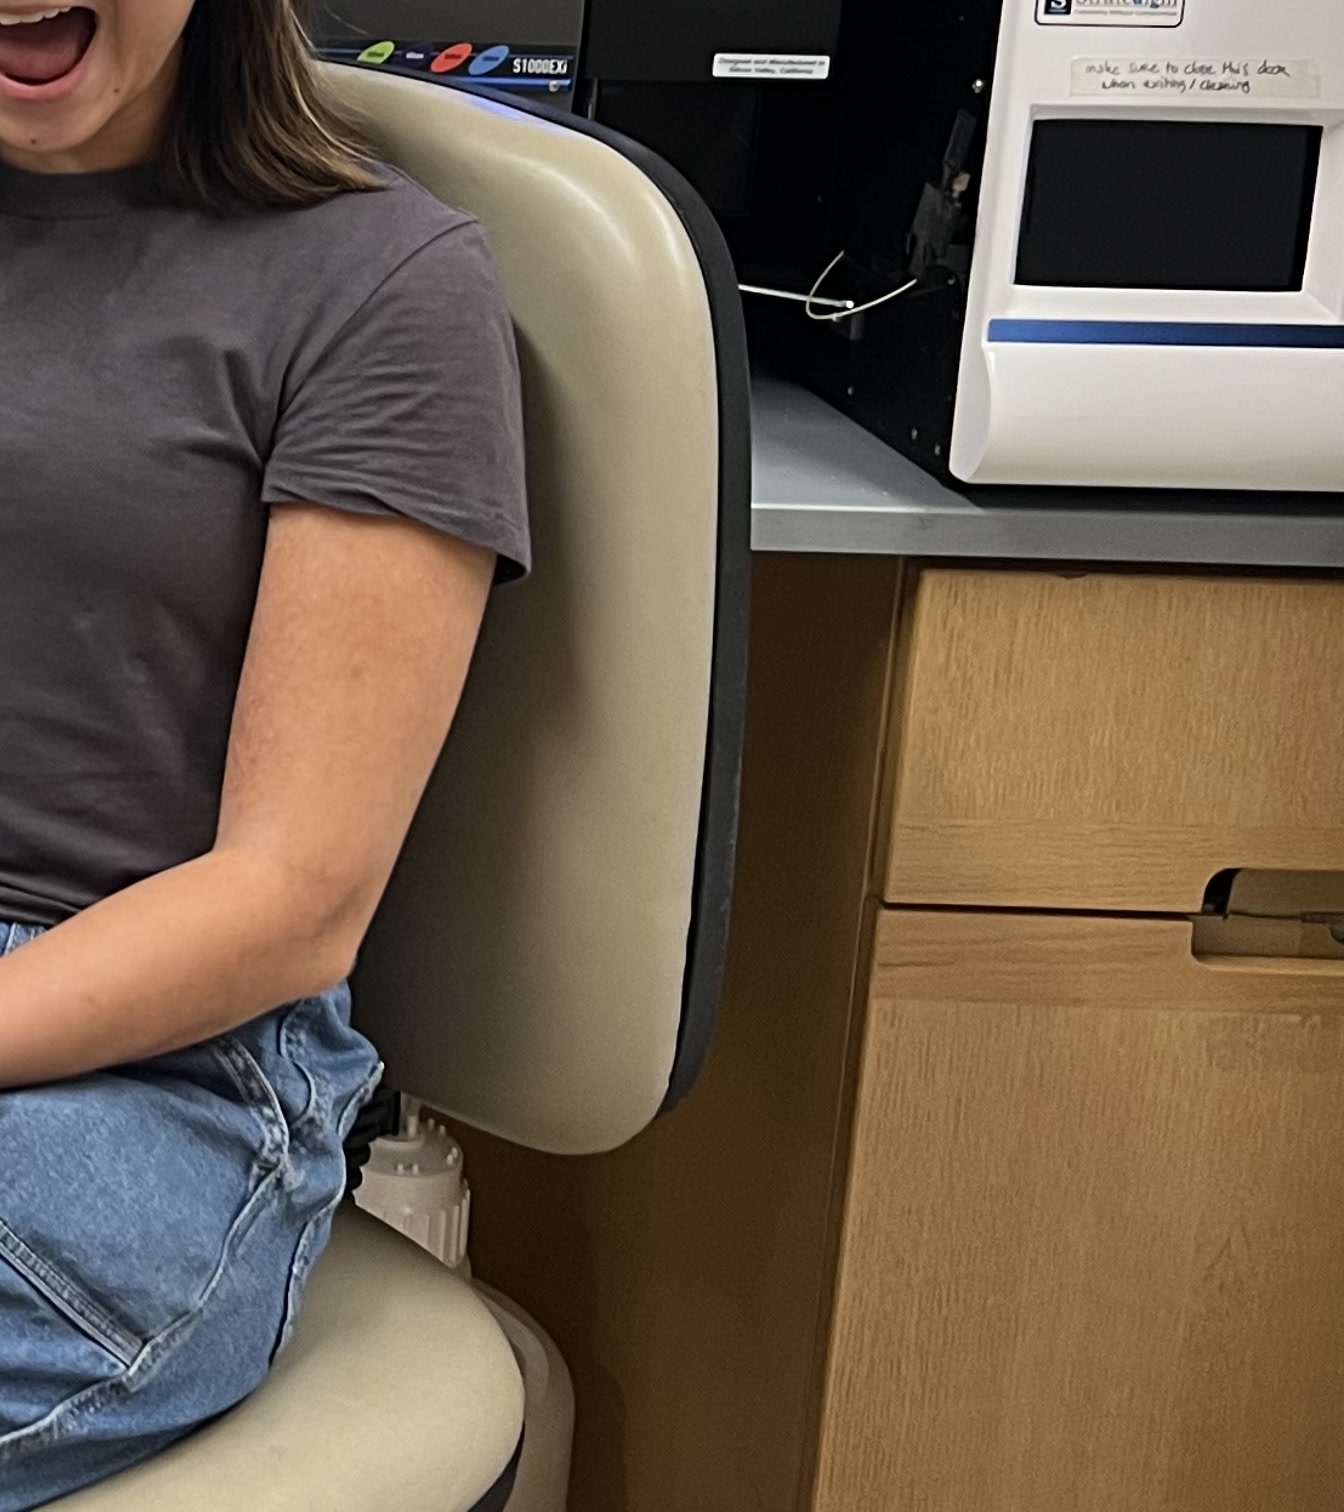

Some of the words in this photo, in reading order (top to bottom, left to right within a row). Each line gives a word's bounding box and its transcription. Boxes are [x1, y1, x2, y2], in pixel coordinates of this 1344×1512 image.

[1085, 60, 1121, 76] make
[1165, 60, 1179, 75] to
[1221, 59, 1249, 77] this
[1101, 78, 1136, 90] when
